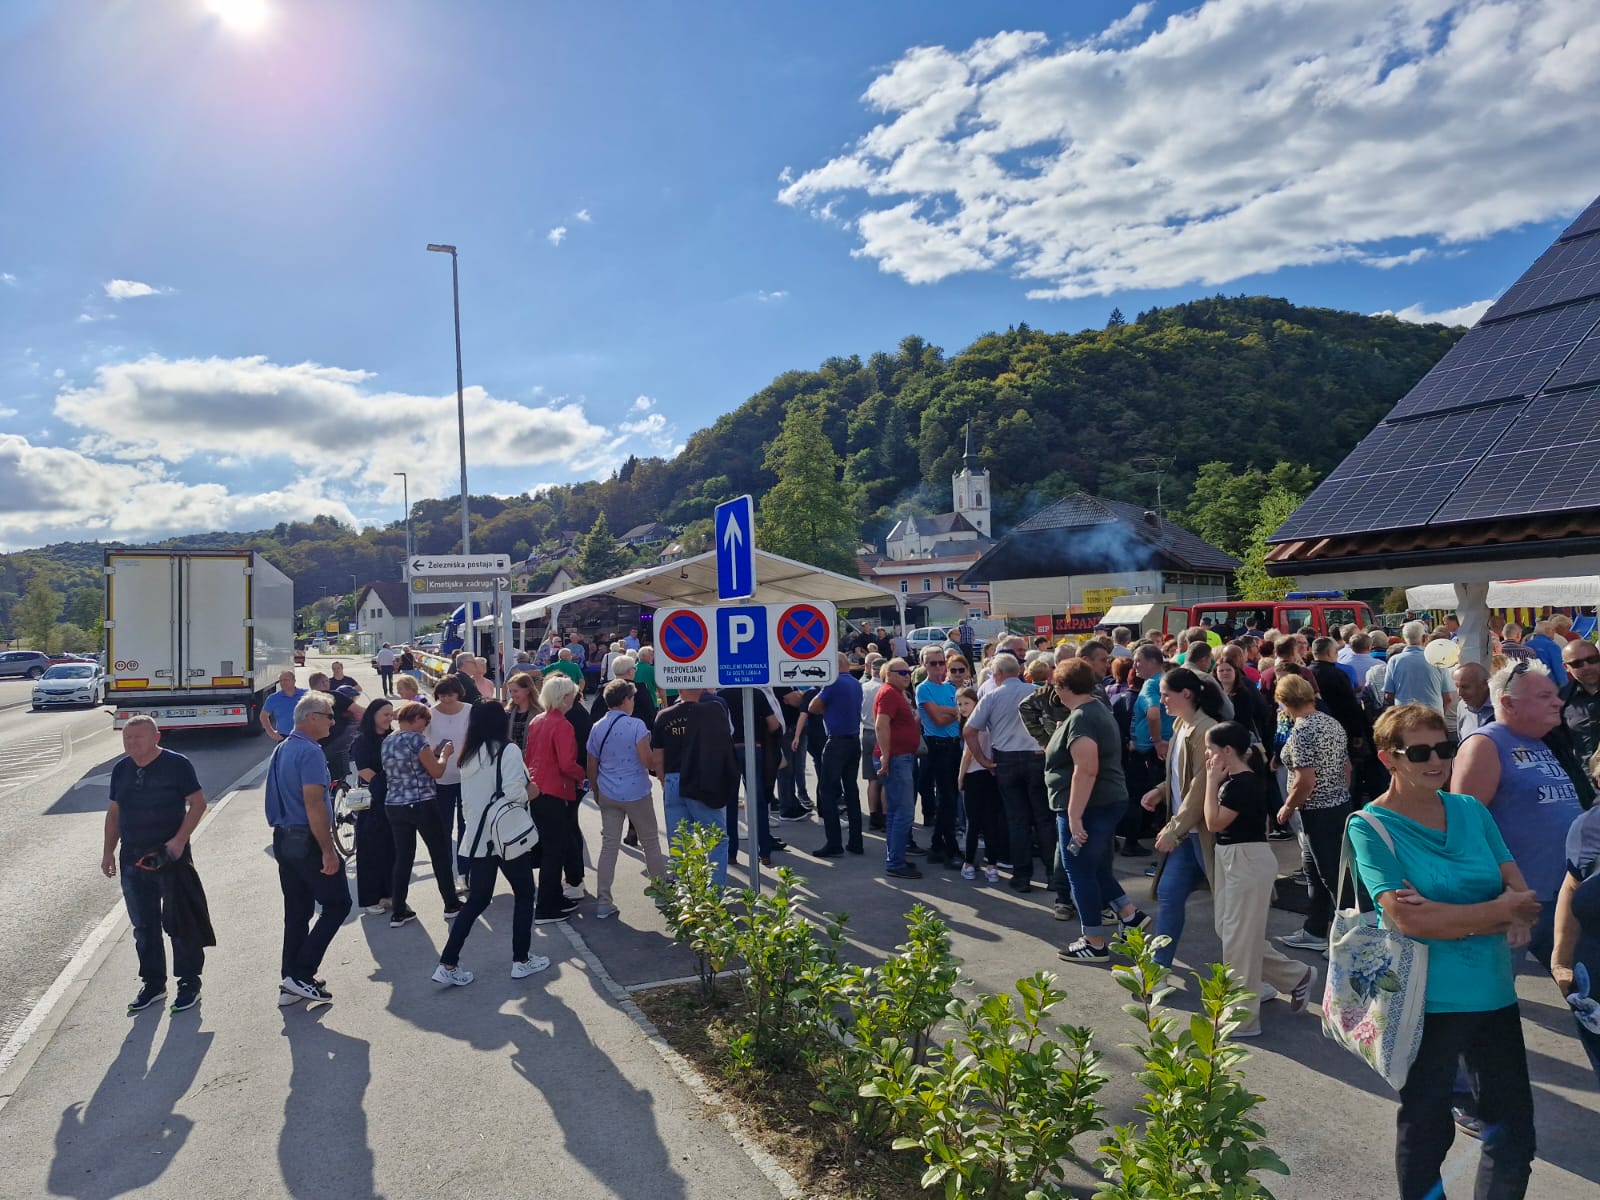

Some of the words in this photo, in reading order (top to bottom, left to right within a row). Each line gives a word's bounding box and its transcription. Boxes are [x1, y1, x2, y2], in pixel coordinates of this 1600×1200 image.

[467, 560, 492, 569] postaja
[429, 581, 463, 589] Kmetijska
[729, 615, 755, 654] P
[663, 665, 707, 674] PREPOVEDANO
